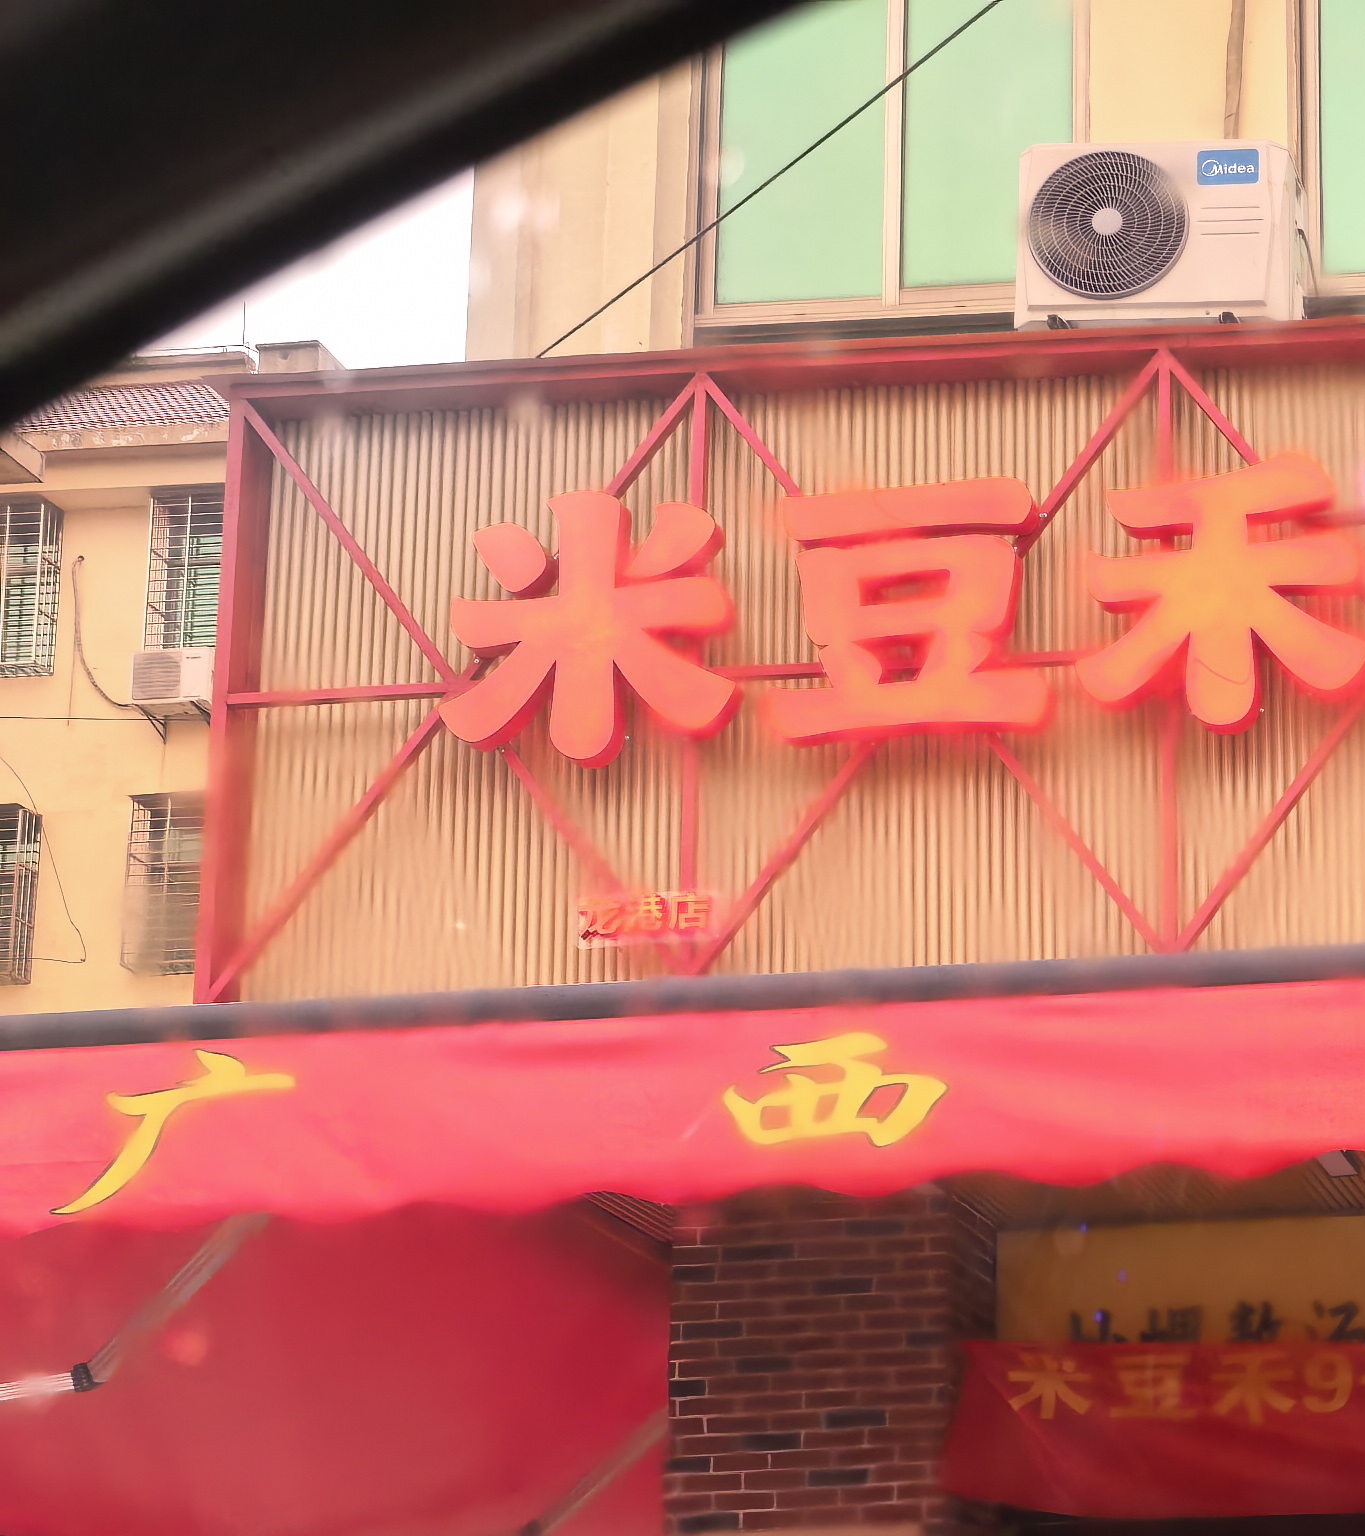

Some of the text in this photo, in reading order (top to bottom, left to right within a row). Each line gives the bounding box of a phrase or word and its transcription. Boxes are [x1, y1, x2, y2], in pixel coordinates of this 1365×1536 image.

[1202, 159, 1255, 177] Midea
[576, 891, 711, 938] 龙港店
